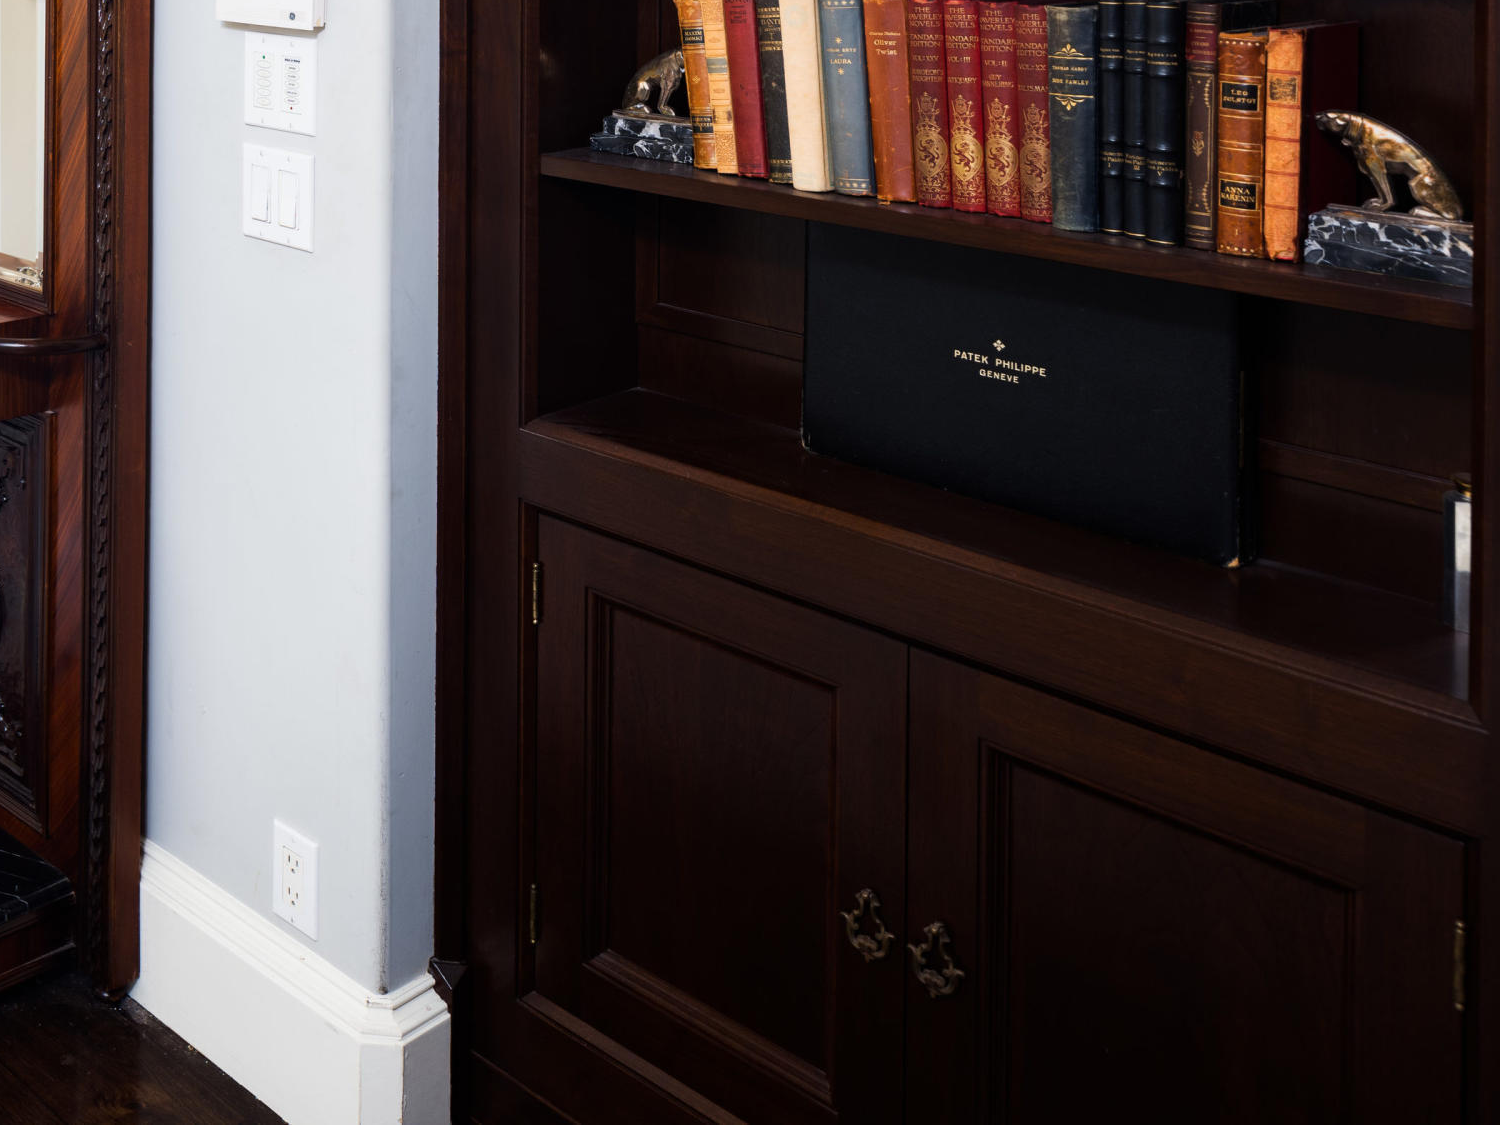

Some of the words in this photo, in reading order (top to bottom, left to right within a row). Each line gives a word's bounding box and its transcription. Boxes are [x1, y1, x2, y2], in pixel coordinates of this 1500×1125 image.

[913, 6, 931, 14] THE
[948, 7, 965, 15] THE
[985, 10, 1003, 18] THE
[1021, 13, 1040, 21] THE
[1017, 20, 1048, 28] AVERLE
[1017, 27, 1048, 35] NOVEL
[1016, 42, 1048, 50] TANDA
[876, 48, 898, 56] Twist
[1230, 88, 1249, 96] LEO
[1225, 186, 1250, 195] ANNA
[954, 349, 989, 364] PATEK
[995, 358, 1047, 377] PHILIPPE
[979, 368, 1020, 384] GENEVE
